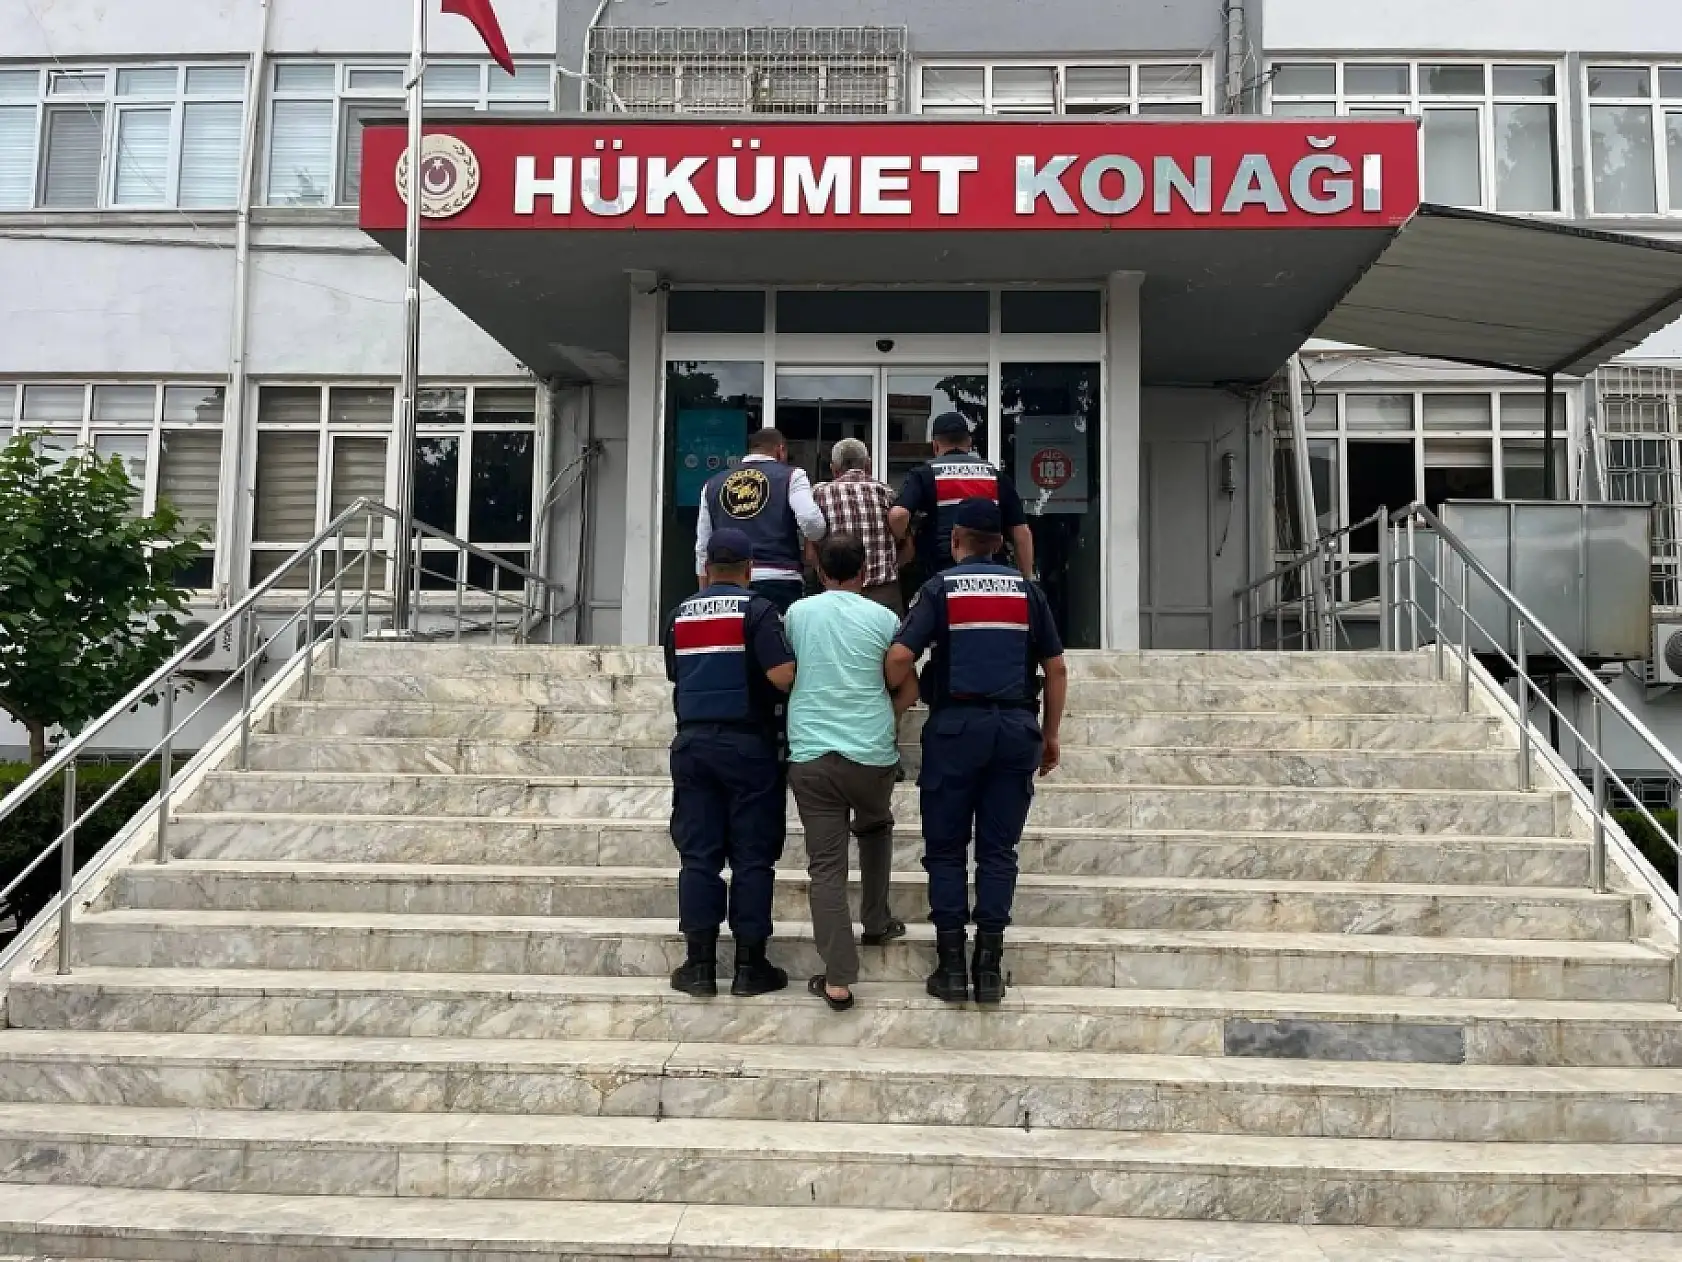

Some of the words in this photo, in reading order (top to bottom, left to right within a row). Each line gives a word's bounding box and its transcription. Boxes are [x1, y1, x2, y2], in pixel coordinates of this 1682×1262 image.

[513, 138, 979, 216] HÜKÜMET
[1015, 135, 1383, 215] KONAĞI
[953, 578, 1019, 592] JANDARMA
